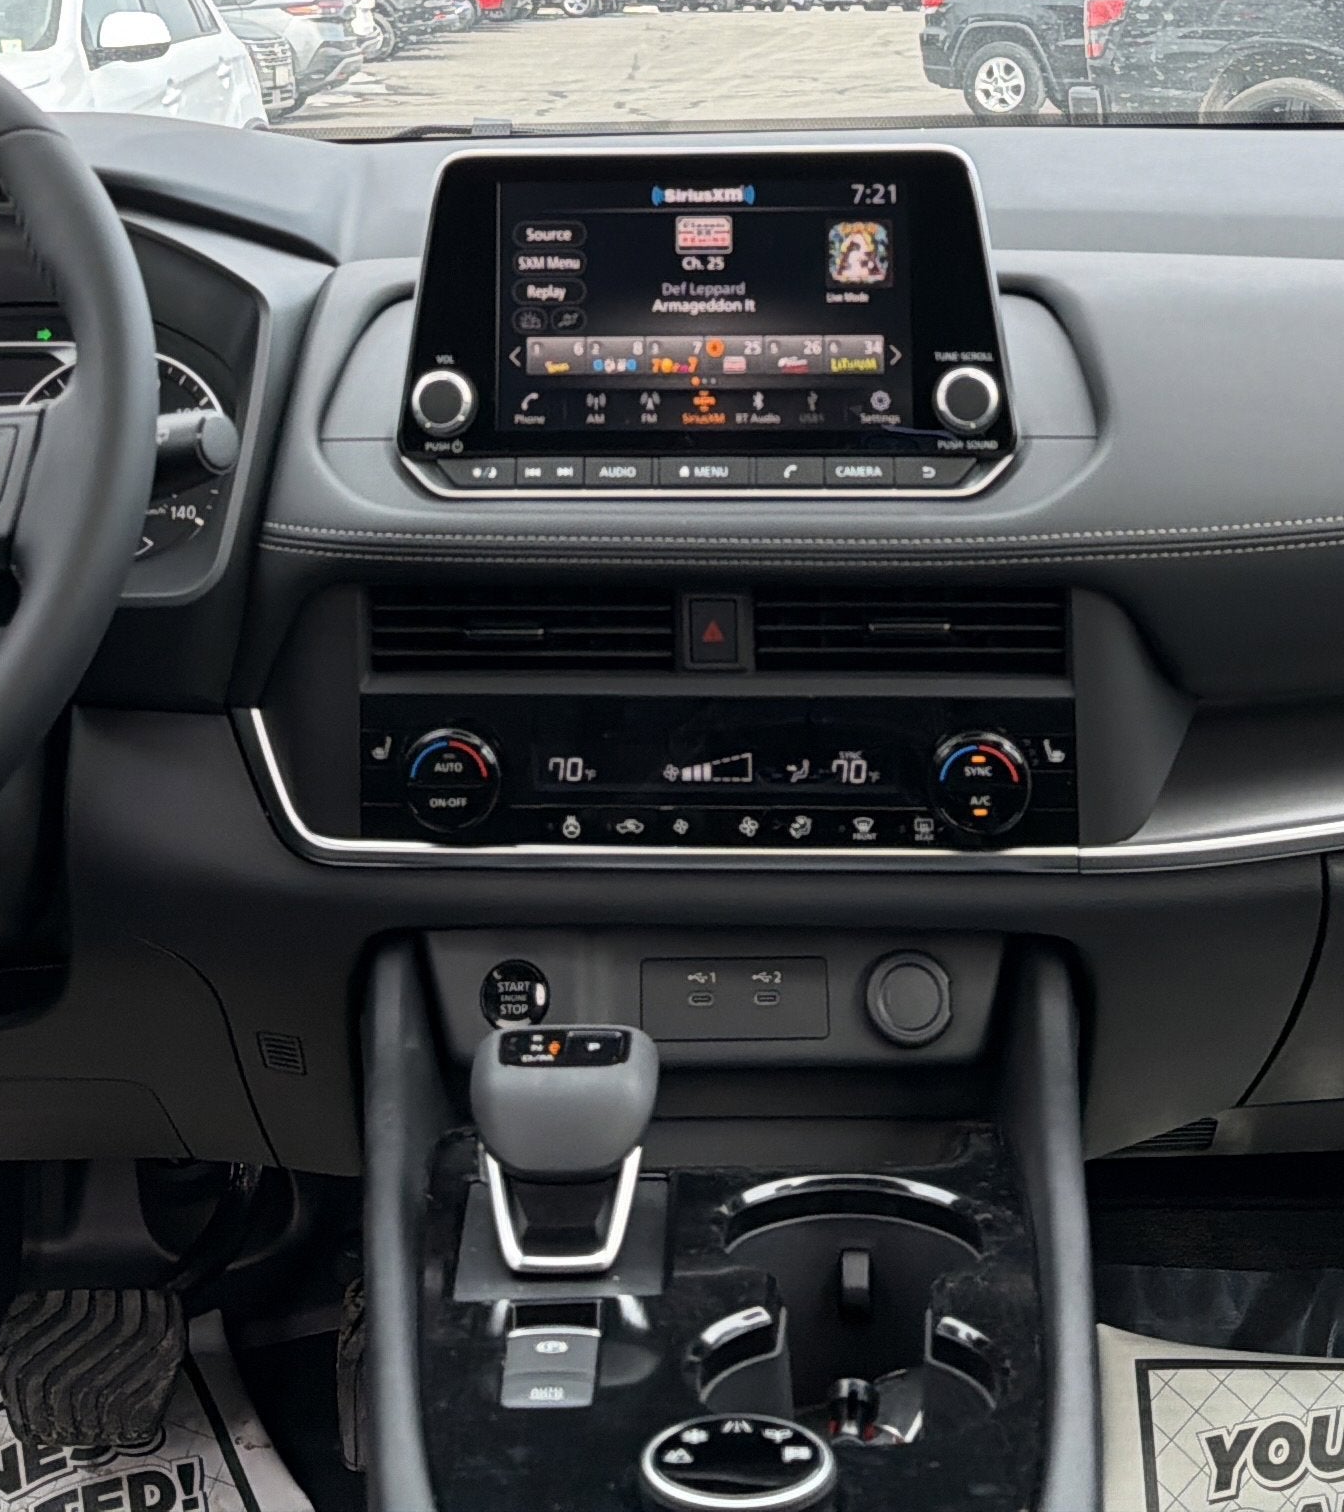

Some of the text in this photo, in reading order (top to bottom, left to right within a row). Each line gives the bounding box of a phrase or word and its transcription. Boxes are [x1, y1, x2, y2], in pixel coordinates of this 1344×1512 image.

[851, 183, 897, 205] 7:21
[525, 227, 573, 242] Source
[547, 256, 581, 270] Menu
[681, 256, 725, 271] Ch. 25
[527, 284, 567, 302] Replay
[661, 282, 746, 298] Def Leppard
[652, 298, 743, 316] Armageddon
[573, 341, 585, 356] 6
[692, 340, 703, 355] 7
[744, 340, 762, 355] 25
[803, 340, 823, 355] 26
[864, 340, 884, 355] 34
[513, 413, 546, 425] Phone
[585, 413, 606, 424] AM
[640, 413, 658, 424] FM
[599, 466, 637, 479] AUDIO
[693, 466, 729, 479] MENU
[834, 465, 883, 479] CAMERA
[170, 504, 197, 521] 140
[433, 761, 464, 774] AUTO
[964, 766, 993, 778] SYNC
[969, 795, 992, 807] A/C
[709, 971, 717, 983] 1
[773, 970, 783, 984] 2
[496, 980, 531, 993] START
[500, 993, 528, 1002] ENGINE
[499, 1003, 529, 1015] STOP
